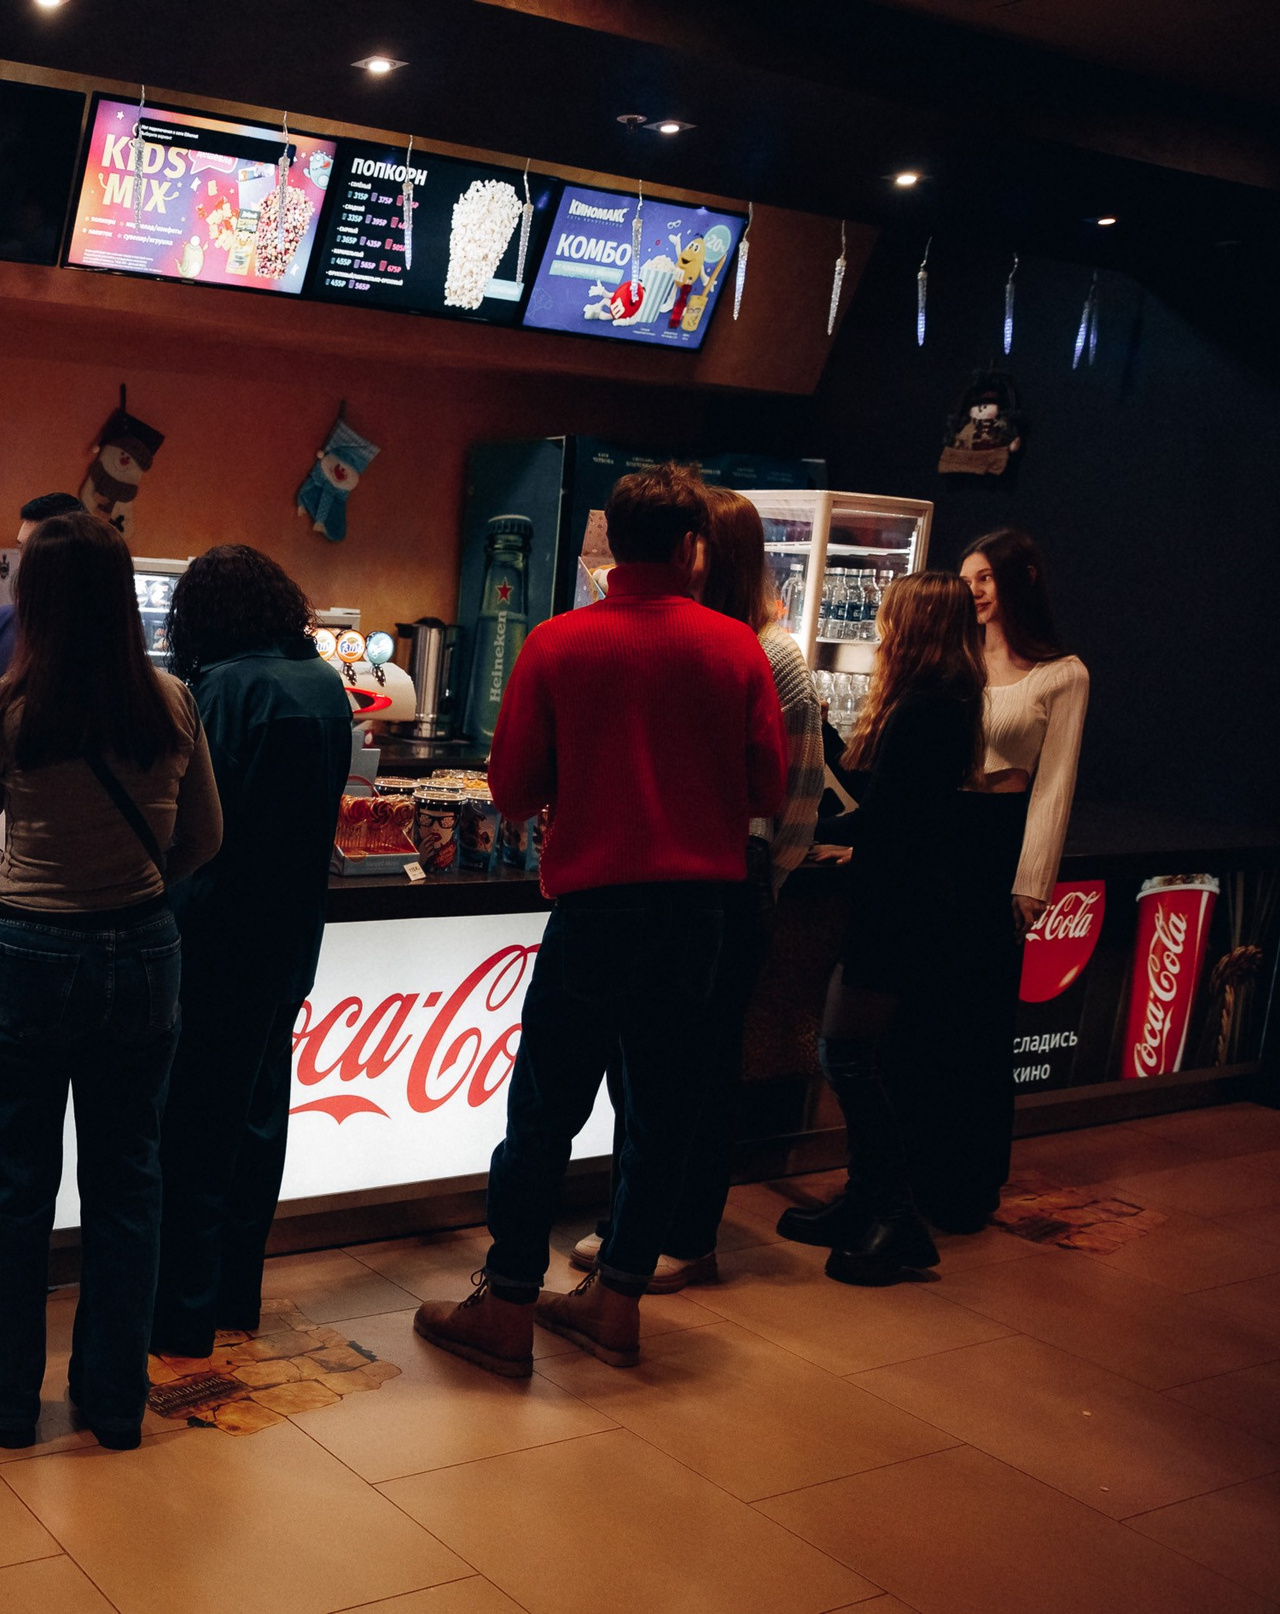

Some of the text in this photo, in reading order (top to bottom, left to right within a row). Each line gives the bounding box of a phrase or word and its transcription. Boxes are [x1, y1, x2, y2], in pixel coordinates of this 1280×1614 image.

[351, 157, 428, 186] ПОПКОРН
[555, 233, 632, 266] КОМБО
[489, 610, 508, 703] Heineken
[1133, 902, 1188, 1078] Coca-Cola
